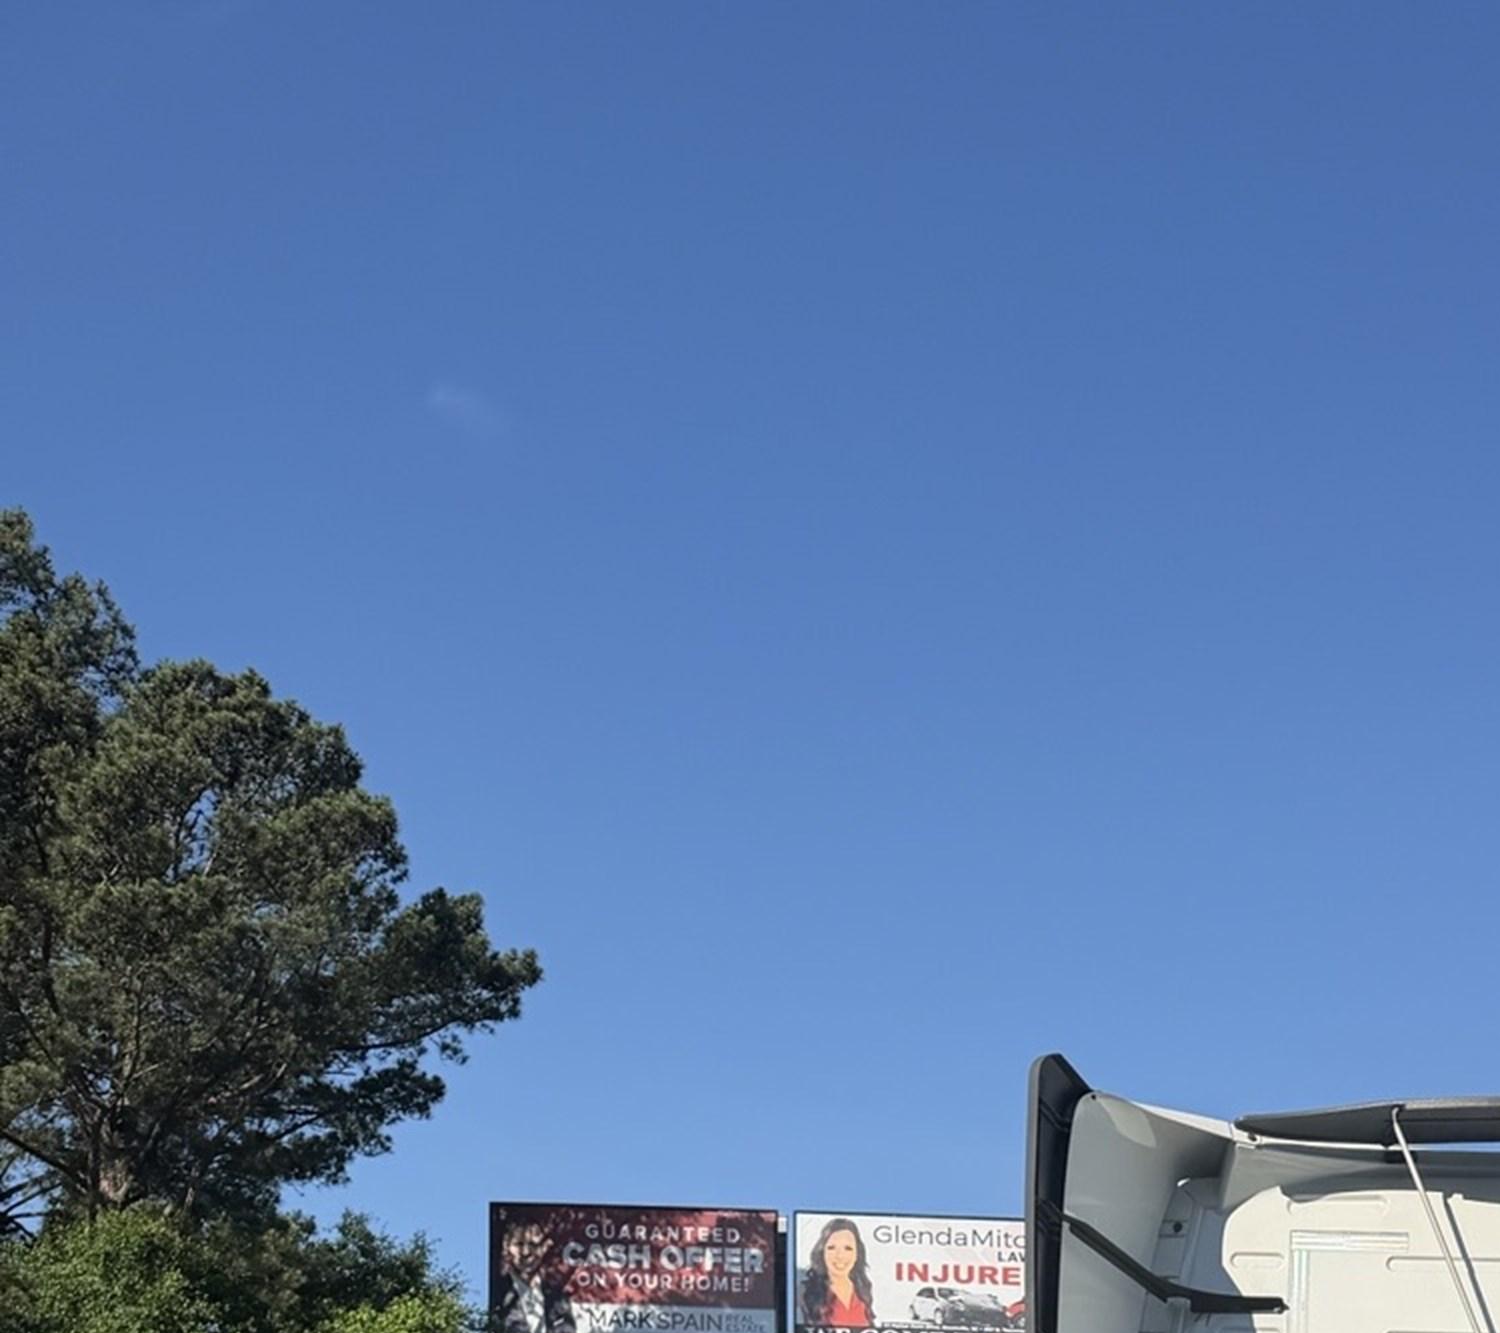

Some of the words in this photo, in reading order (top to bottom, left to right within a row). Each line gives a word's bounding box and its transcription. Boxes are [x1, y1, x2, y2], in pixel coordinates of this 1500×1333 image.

[585, 1223, 741, 1242] GUARANTEED
[562, 1241, 650, 1269] CASH
[659, 1245, 765, 1274] OFFER
[576, 1270, 607, 1289] ON
[613, 1272, 672, 1290] YOUR
[681, 1275, 750, 1293] HOME!
[895, 1262, 1021, 1287] INJURE
[588, 1309, 653, 1330] MARK
[656, 1311, 723, 1332] SPAIN
[725, 1315, 754, 1325] REAL
[725, 1324, 765, 1333] ESTATE
